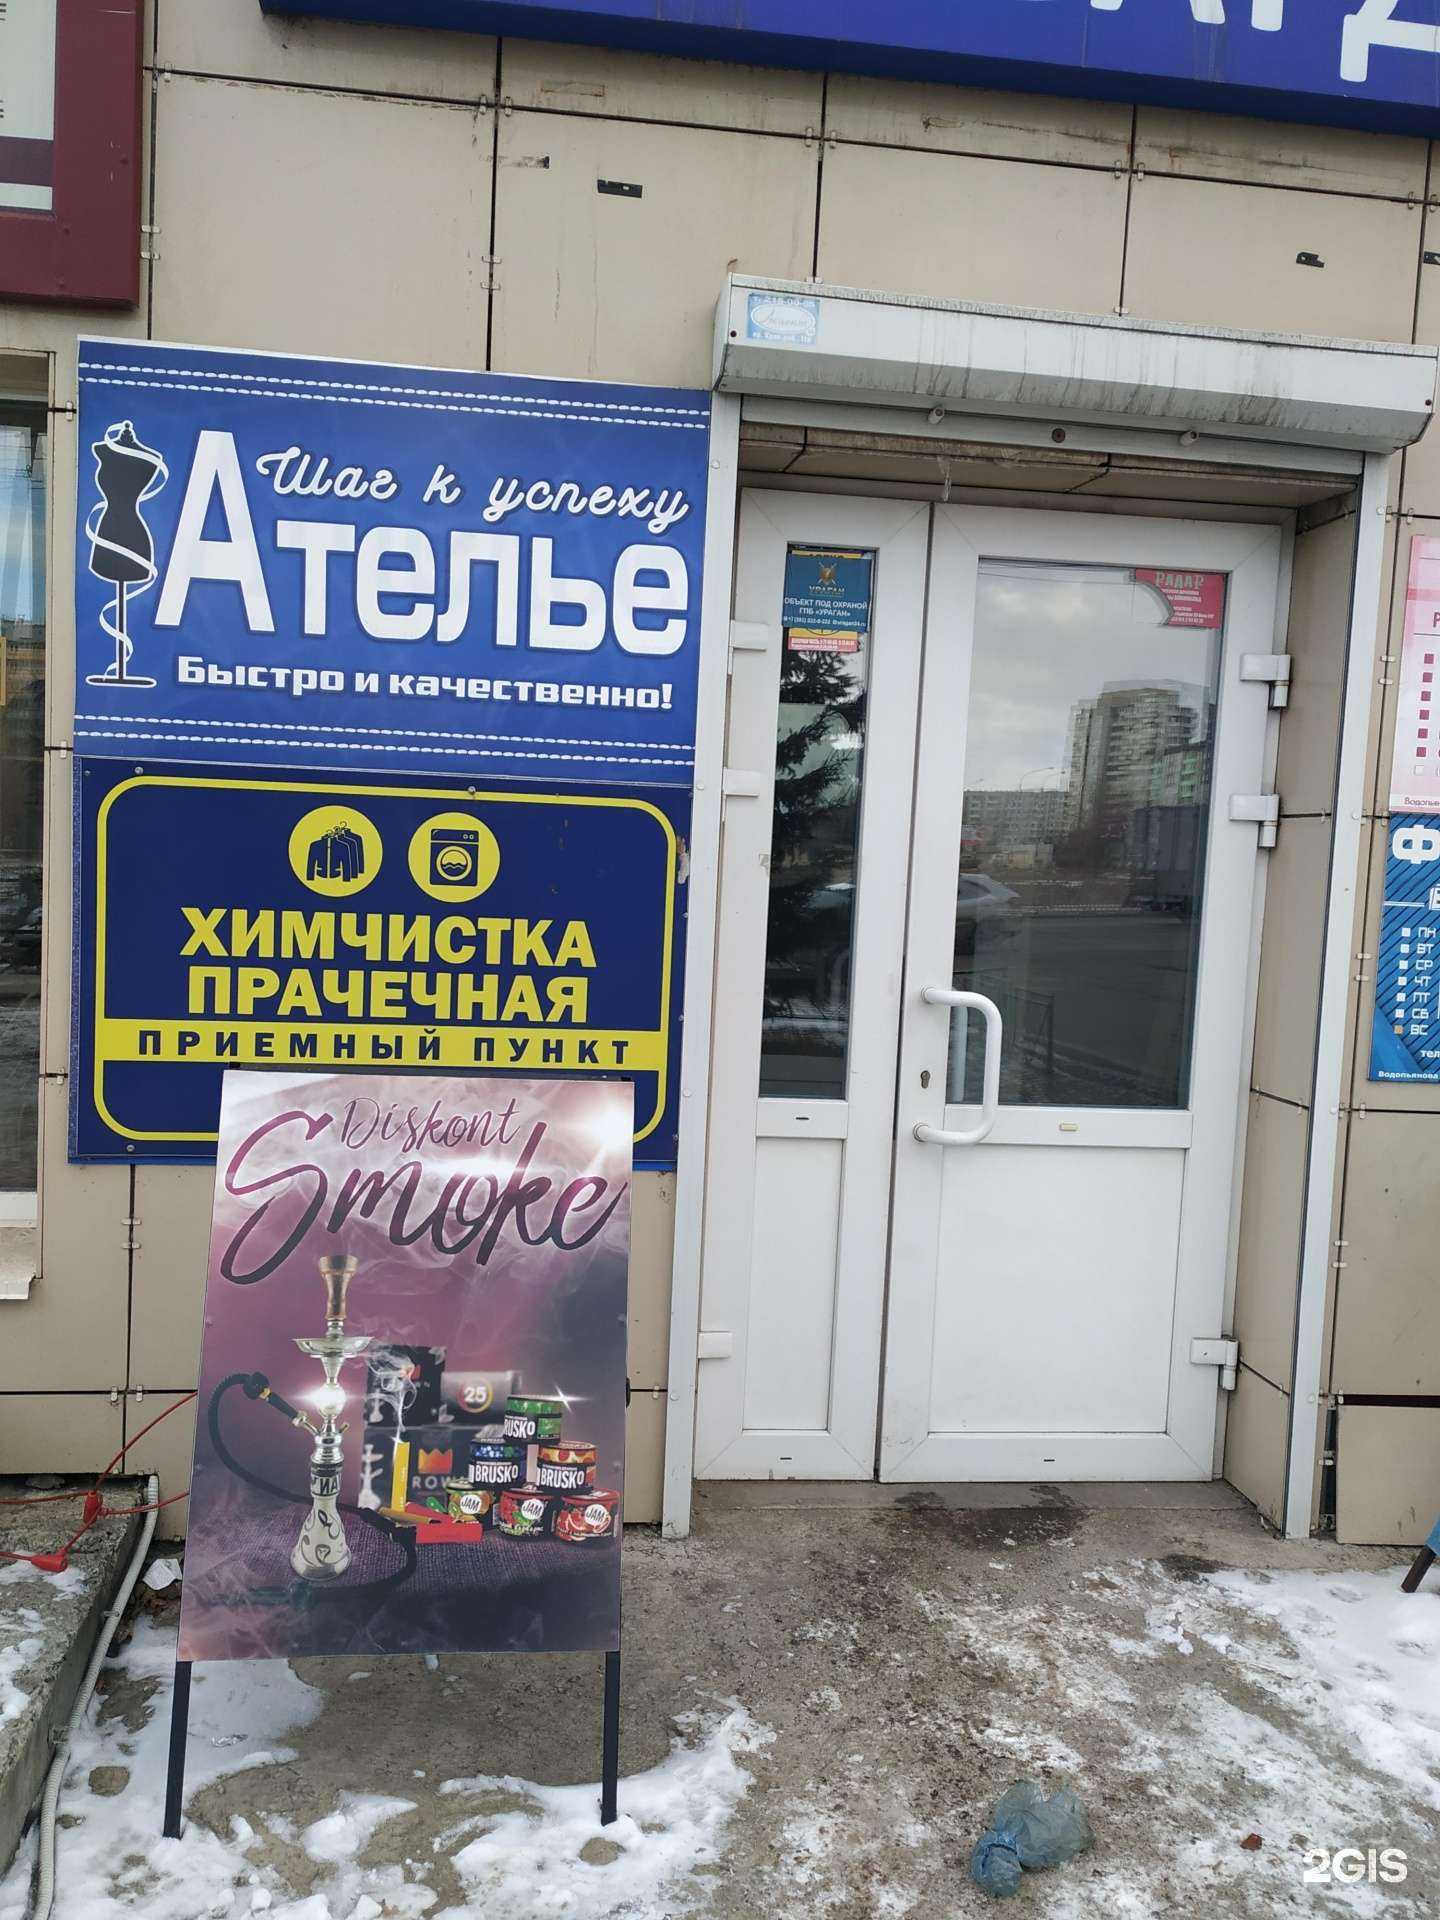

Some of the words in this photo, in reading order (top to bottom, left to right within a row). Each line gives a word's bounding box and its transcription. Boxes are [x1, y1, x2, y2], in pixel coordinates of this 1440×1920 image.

[256, 446, 398, 499] Шаг
[423, 464, 462, 504] к
[483, 476, 690, 534] успеху
[154, 429, 690, 656] Ателье
[784, 597, 813, 606] ОБЪЕКТ
[815, 600, 832, 609] ПОД
[832, 601, 868, 610] ОХРАНОЙ
[177, 655, 347, 695] Быстро
[355, 671, 380, 693] и
[389, 671, 674, 709] качественно!
[179, 906, 598, 968] ХИМЧИСТКА
[1418, 926, 1437, 938] ПН
[1416, 943, 1434, 955] ВТ
[1415, 959, 1434, 971] СР
[1414, 976, 1432, 987] ЧТ
[188, 965, 591, 1024] ПРАЧЕЧНАЯ
[1412, 991, 1431, 1003] ПТ
[1411, 1008, 1429, 1020] СБ
[1410, 1024, 1429, 1036] ВС
[138, 1027, 443, 1061] ПРИЕМНЫЙ
[473, 1038, 630, 1064] ПУНКТ
[1378, 1070, 1439, 1079] Водопьянова
[341, 1096, 521, 1154] Diskont
[220, 1121, 629, 1285] Smoke
[463, 1386, 488, 1403] 25
[475, 1463, 519, 1484] BRUSKO
[540, 1467, 585, 1489] BRUSKO
[461, 1496, 480, 1511] JAM
[523, 1500, 543, 1517] JAM
[586, 1507, 605, 1524] JAM
